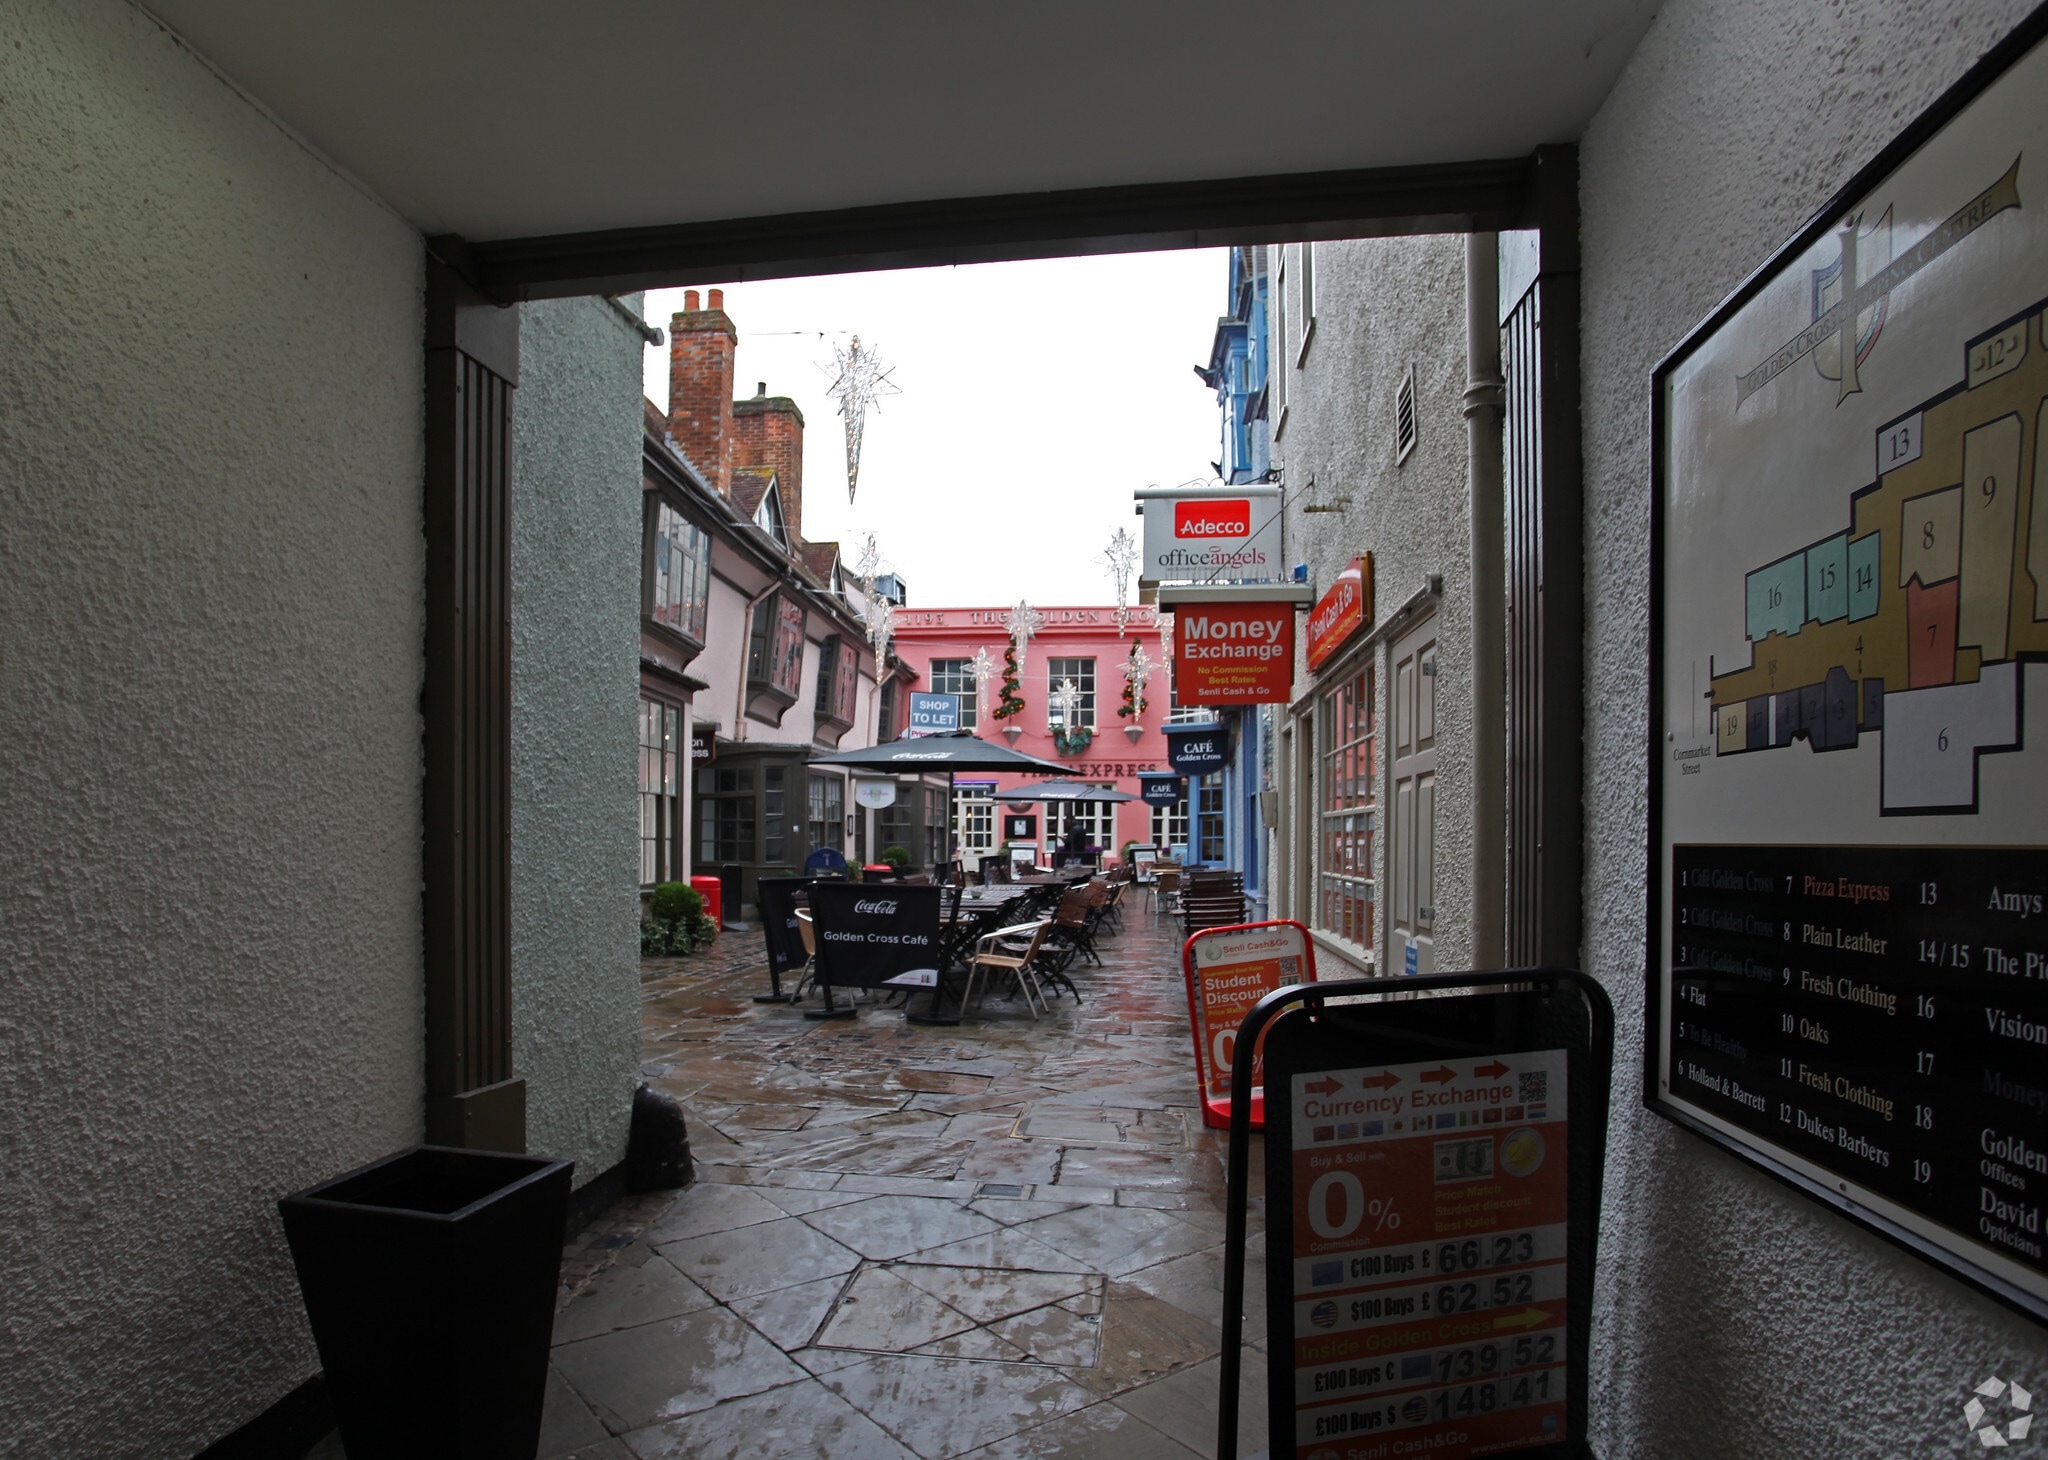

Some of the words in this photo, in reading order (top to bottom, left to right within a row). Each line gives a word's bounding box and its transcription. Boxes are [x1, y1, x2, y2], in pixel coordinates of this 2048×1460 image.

[1986, 338, 2005, 370] 12
[1890, 427, 1910, 462] 13
[1982, 475, 1996, 509] 9
[1180, 518, 1245, 535] Adecco
[1922, 520, 1935, 550] 8
[1819, 562, 1836, 592] 15
[1855, 563, 1872, 594] 14
[1767, 582, 1782, 610] 16
[1034, 609, 1099, 623] OLDEN
[1110, 609, 1152, 623] CRO
[1184, 616, 1284, 644] Money
[1927, 624, 1937, 649] 7
[1185, 642, 1284, 660] Exchange
[1855, 634, 1864, 655] 4
[1198, 666, 1211, 675] No
[1212, 665, 1268, 675] Commission
[1208, 676, 1229, 685] Best
[1231, 676, 1257, 684] Rates
[1198, 688, 1220, 696] Senli
[1223, 687, 1246, 696] Cash
[1248, 687, 1254, 695] &
[1257, 687, 1270, 695] Go
[919, 700, 949, 711] SHOP
[913, 713, 930, 724] TO
[932, 713, 955, 725] LET
[1727, 715, 1738, 736] 19
[1752, 711, 1762, 730] 17
[1183, 739, 1214, 754] CAFÉ
[1937, 727, 1948, 752] 6
[1176, 754, 1201, 762] Golden
[1202, 753, 1222, 761] Cross
[1673, 744, 1711, 761] Cornmarket
[1681, 762, 1701, 776] Street
[1151, 783, 1171, 793] CAFÉ
[1682, 870, 1687, 886] 1
[1745, 871, 1775, 893] Cross
[1785, 876, 1793, 895] 7
[1803, 874, 1835, 897] Pizza
[1838, 877, 1890, 905] Express
[854, 899, 899, 915] Coca-Cola
[1919, 881, 1938, 906] 13
[1987, 885, 2043, 920] Amys
[1682, 908, 1687, 924] 2
[1745, 912, 1774, 937] Cross
[823, 931, 864, 943] Golden
[867, 933, 899, 944] Cross
[902, 934, 929, 946] Café
[1223, 944, 1245, 954] Senli
[1247, 938, 1289, 951] Cash&Go
[1783, 921, 1791, 941] 8
[1802, 923, 1833, 947] Plain
[1836, 928, 1888, 956] Leather
[1681, 947, 1687, 963] 3
[1744, 957, 1774, 982] Cross
[1983, 946, 2019, 976] The
[1205, 972, 1262, 991] Student
[1783, 967, 1791, 986] 9
[1801, 970, 1833, 997] Fresh
[1837, 977, 1897, 1016] Clothing
[1206, 985, 1271, 1005] Discount
[1680, 984, 1686, 1000] 4
[1689, 986, 1707, 1008] Flat
[1916, 994, 1936, 1019] 16
[1679, 1021, 1685, 1038] 5
[1781, 1013, 1794, 1034] 10
[1799, 1017, 1829, 1046] Oaks
[1916, 1050, 1936, 1076] 17
[1678, 1058, 1684, 1076] 6
[1688, 1063, 1720, 1093] Holland
[1722, 1077, 1731, 1096] &
[1732, 1081, 1766, 1112] Barrett
[1780, 1057, 1792, 1079] 11
[1798, 1062, 1832, 1094] Fresh
[1834, 1075, 1895, 1122] Clothing
[1304, 1095, 1404, 1120] Currency
[1411, 1084, 1513, 1108] Exchange
[1779, 1102, 1791, 1124] 12
[1797, 1108, 1835, 1145] Dukes
[1838, 1127, 1890, 1168] Barbers
[1914, 1104, 1933, 1130] 18
[1980, 1128, 2048, 1175] Golden
[1310, 1154, 1331, 1168] Buy
[1335, 1153, 1344, 1165] &
[1346, 1150, 1366, 1164] Sell
[1980, 1158, 2026, 1191] Offices
[1434, 1189, 1463, 1202] Price
[1467, 1183, 1502, 1198] Match
[1913, 1158, 1932, 1184] 19
[1980, 1186, 2040, 1234] David
[1435, 1203, 1480, 1218] Student
[1482, 1195, 1532, 1212] discount
[1435, 1220, 1461, 1233] Best
[1464, 1216, 1497, 1231] Rates
[1309, 1236, 1371, 1253] Commission
[1979, 1216, 2042, 1259] Opticians
[1351, 1256, 1380, 1279] €100
[1384, 1253, 1414, 1274] Buys
[1422, 1248, 1430, 1269] £
[1351, 1297, 1381, 1322] $100
[1384, 1295, 1414, 1315] Buys
[1422, 1291, 1430, 1311] £
[1301, 1339, 1359, 1362] Inside
[1366, 1329, 1433, 1352] Golden
[1439, 1320, 1492, 1340] Cross
[1314, 1368, 1346, 1393] £100
[1350, 1365, 1381, 1388] Buys
[1386, 1361, 1394, 1381] €
[1316, 1412, 1347, 1437] £100
[1351, 1408, 1382, 1431] Buys
[1387, 1404, 1396, 1425] $
[1346, 1441, 1388, 1460] Senli
[1392, 1429, 1469, 1456] Cash&Go
